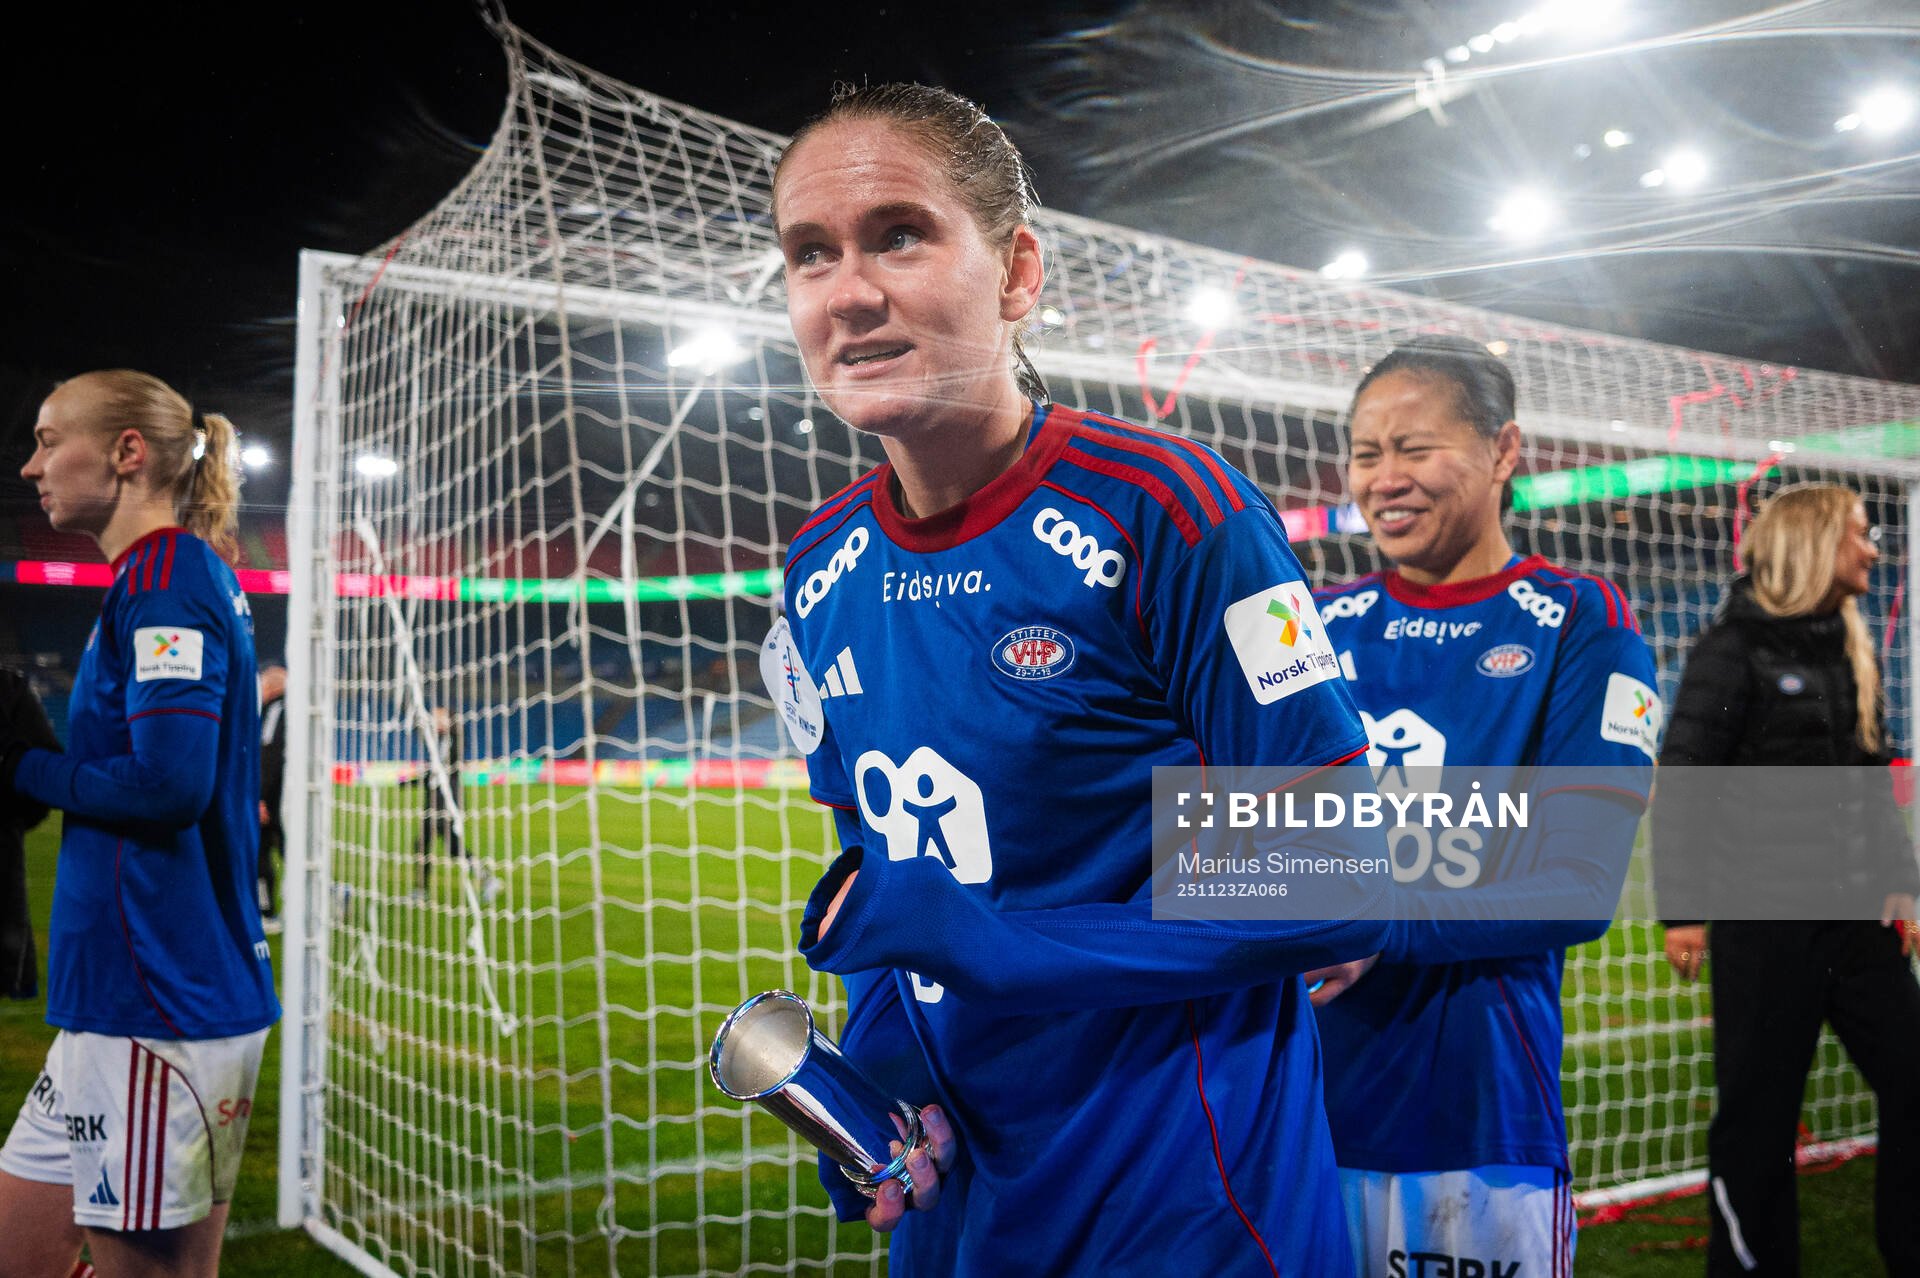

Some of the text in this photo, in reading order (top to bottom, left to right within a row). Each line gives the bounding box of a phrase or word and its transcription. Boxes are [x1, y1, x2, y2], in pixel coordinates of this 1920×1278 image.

[795, 526, 870, 619] coop
[1032, 507, 1126, 588] coop
[1010, 629, 1057, 641] STIFTET
[1257, 659, 1310, 690] Norsk
